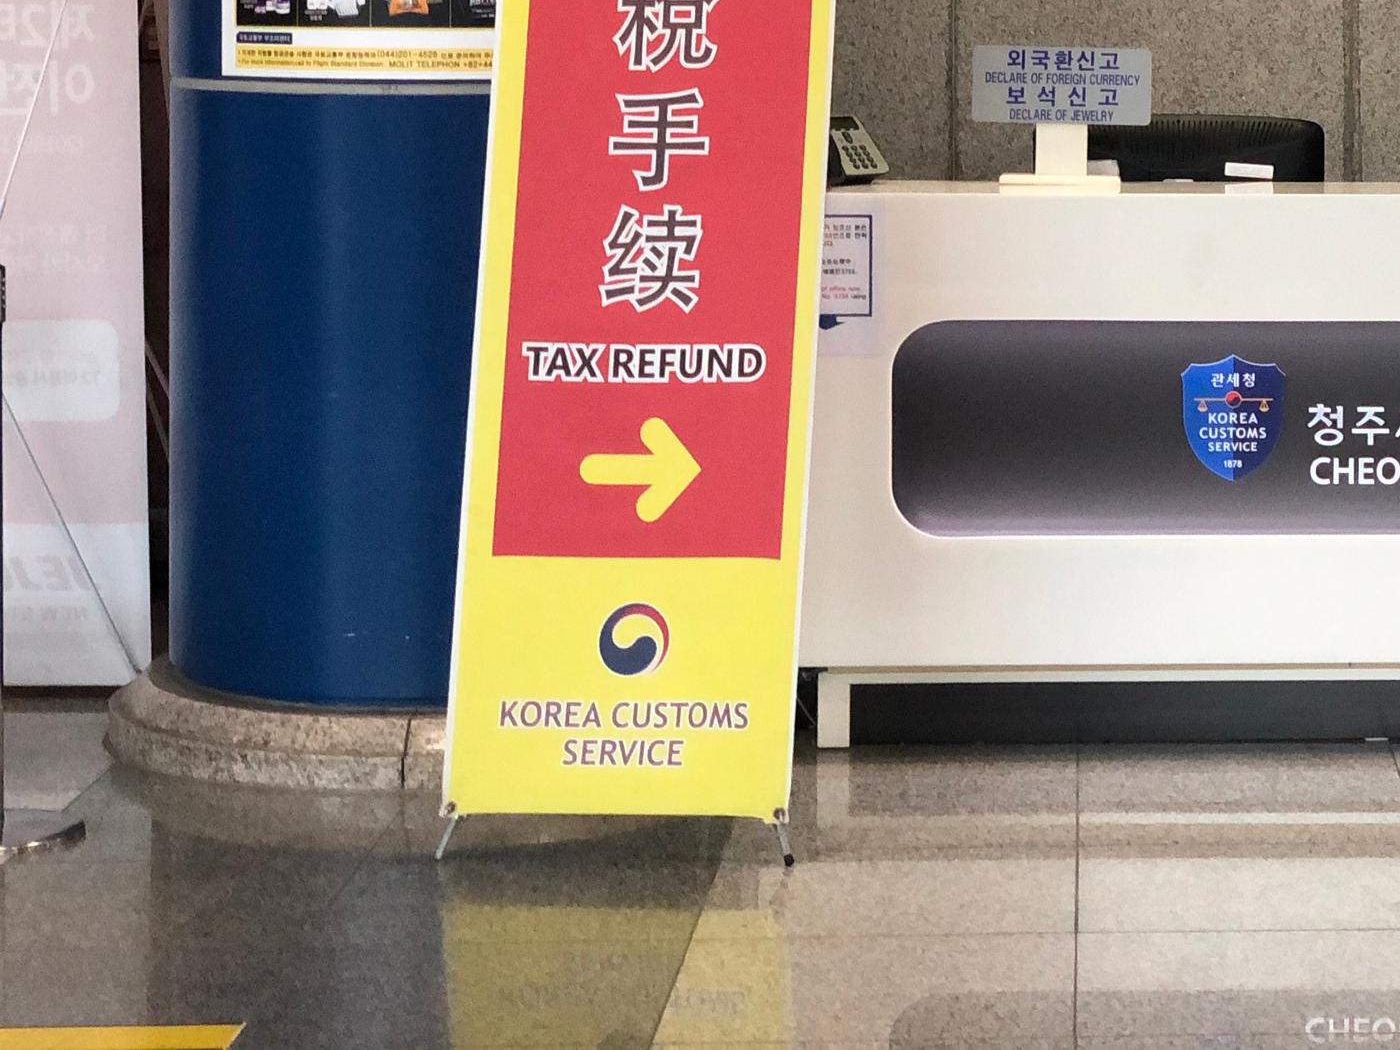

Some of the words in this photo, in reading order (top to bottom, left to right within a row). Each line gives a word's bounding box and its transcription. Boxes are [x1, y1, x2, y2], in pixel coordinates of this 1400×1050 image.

[1007, 50, 1120, 71] 외국환신고
[985, 72, 1027, 84] DECLARE
[1031, 73, 1043, 84] OF
[1046, 72, 1086, 85] FOREIGN
[1090, 74, 1140, 86] CURRENCY
[1009, 109, 1052, 121] DECLARE
[1055, 110, 1068, 121] OF
[1071, 110, 1114, 122] JEWELRY
[521, 342, 604, 383] TAX
[609, 342, 767, 383] REFUND
[1211, 373, 1256, 388] 관세청
[1208, 413, 1258, 424] KOREA
[1199, 427, 1267, 439] CUSTOMS
[1208, 442, 1258, 452] SERVICE
[1224, 460, 1242, 468] 1878
[499, 700, 602, 728] KOREA
[611, 702, 749, 729] CUSTOMS
[563, 739, 684, 767] SERVICE
